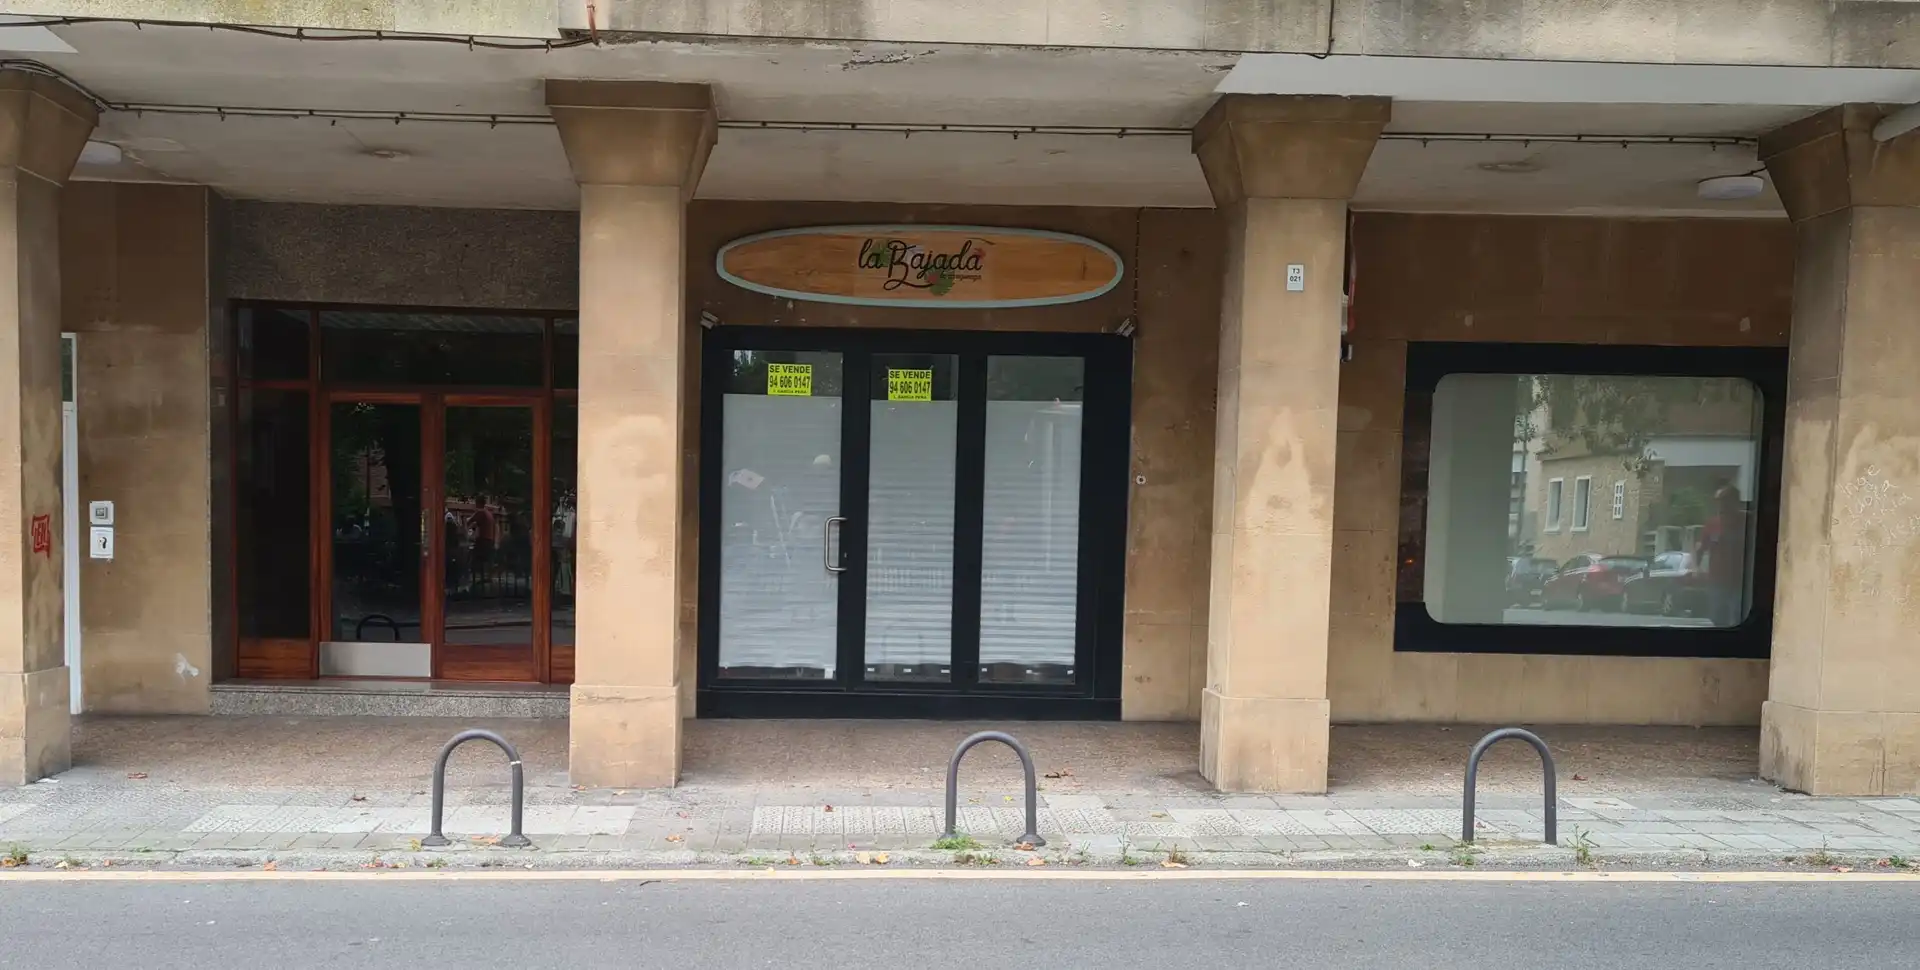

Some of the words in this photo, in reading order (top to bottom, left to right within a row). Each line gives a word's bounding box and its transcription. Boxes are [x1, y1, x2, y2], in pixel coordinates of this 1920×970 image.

[858, 239, 882, 269] la
[883, 239, 983, 291] Bajada
[769, 365, 780, 373] SE
[782, 365, 811, 374] VENDE
[889, 370, 900, 379] SE
[902, 371, 931, 379] VENDE
[769, 375, 778, 388] 94
[780, 375, 792, 389] 606
[793, 376, 811, 389] 0147
[889, 381, 898, 394] 94
[900, 381, 912, 394] 606
[914, 381, 931, 394] 0147
